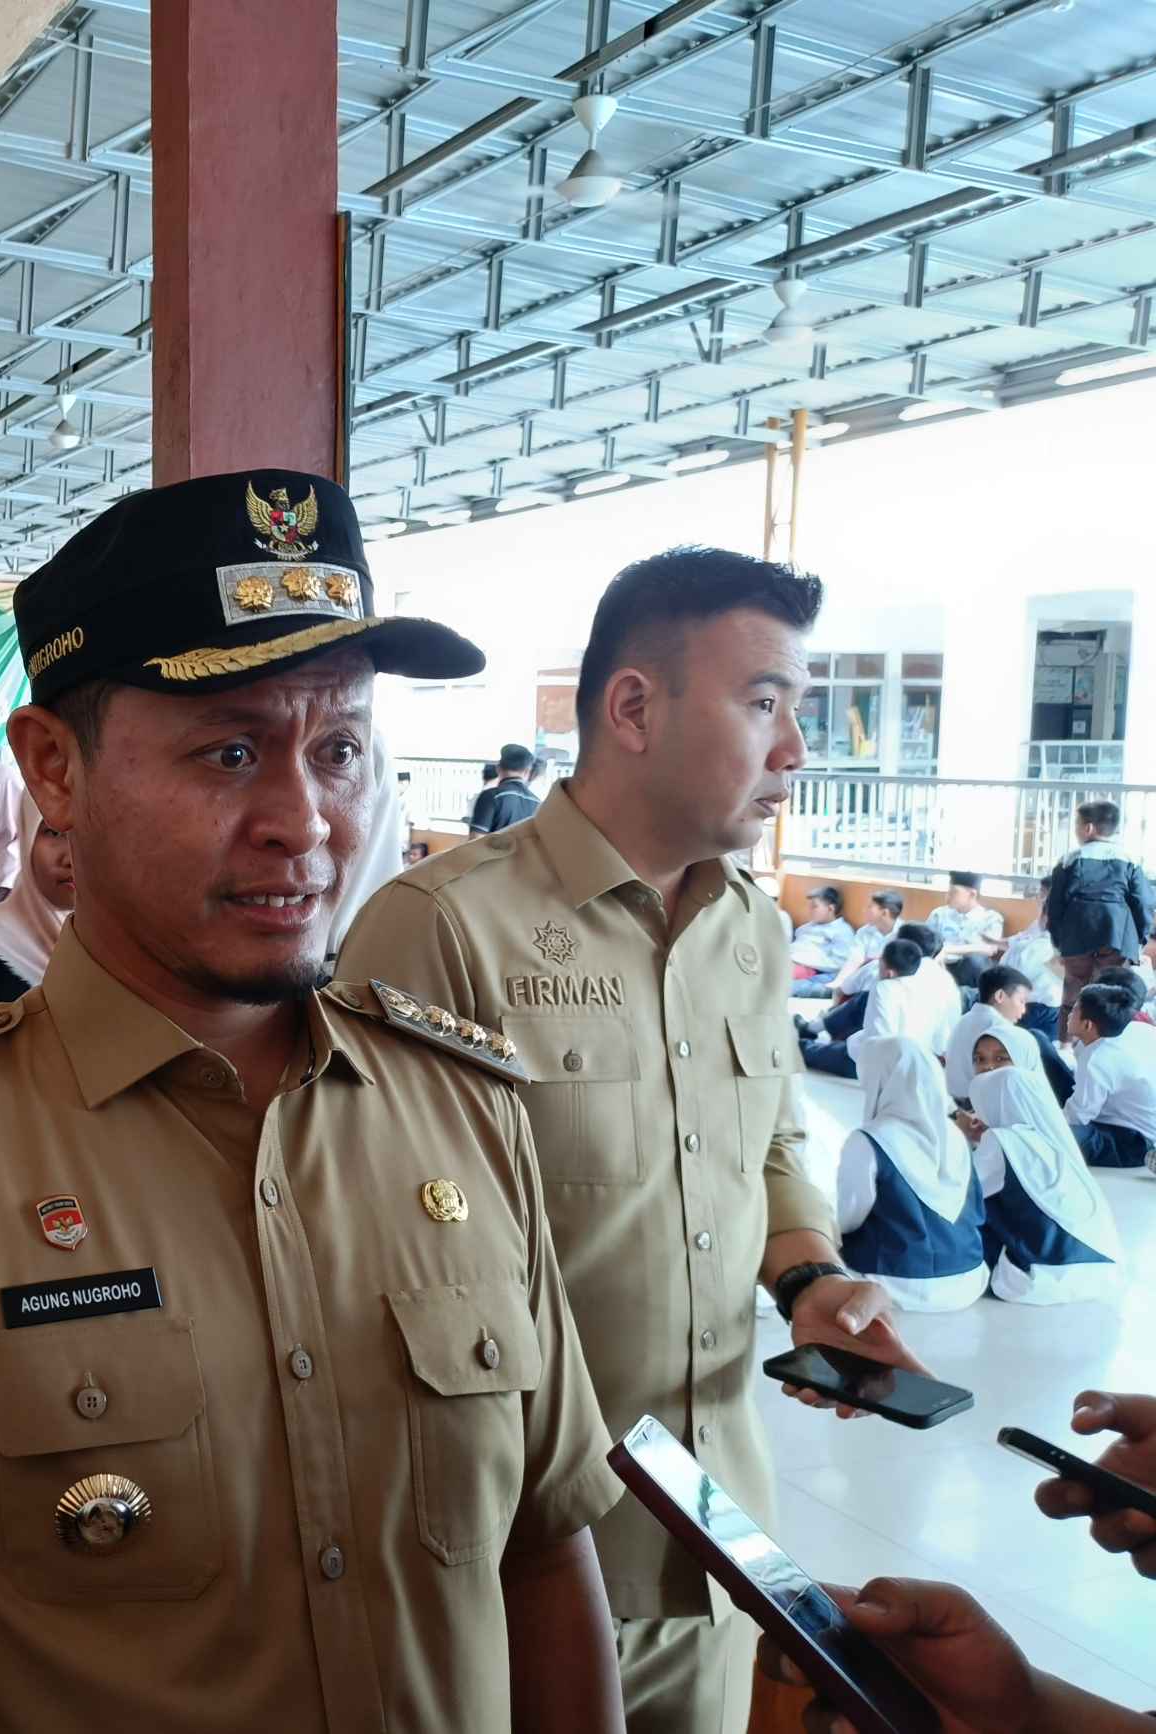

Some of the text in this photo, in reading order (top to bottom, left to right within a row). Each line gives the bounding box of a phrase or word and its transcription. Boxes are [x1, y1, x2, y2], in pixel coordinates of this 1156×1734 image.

[506, 974, 625, 1008] FIRMAN
[21, 1281, 141, 1313] AGUNG NUGROHO
